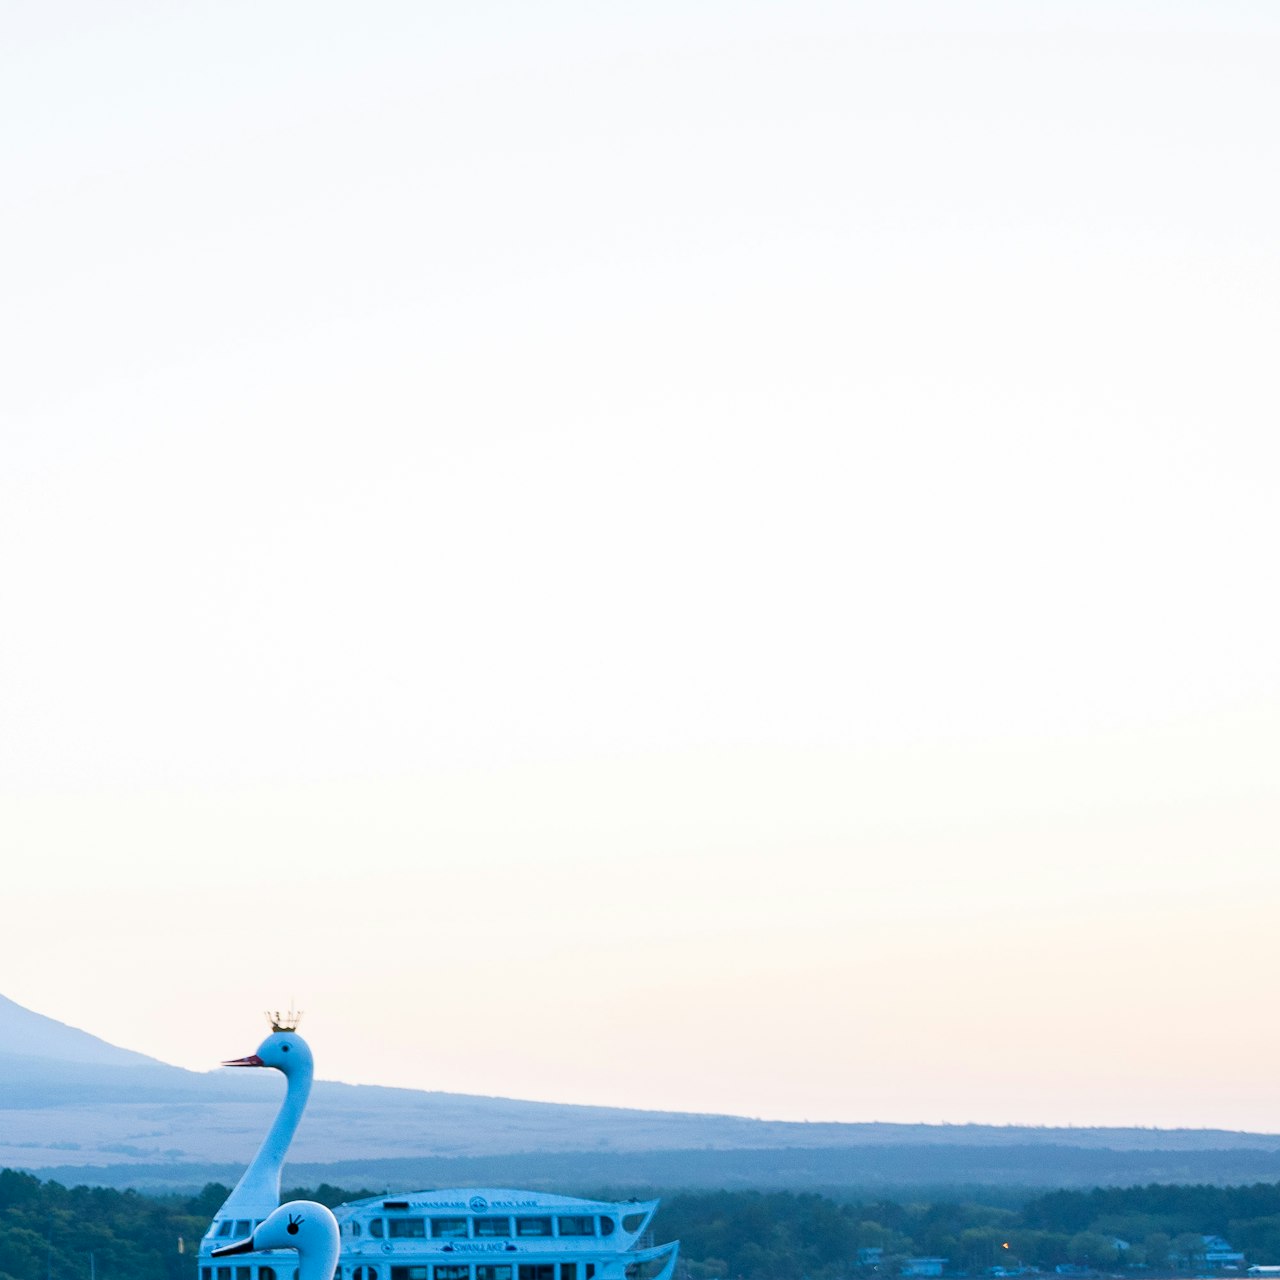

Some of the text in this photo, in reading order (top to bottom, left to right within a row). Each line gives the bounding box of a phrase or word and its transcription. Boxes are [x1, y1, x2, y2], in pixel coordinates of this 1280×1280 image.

[491, 1200, 514, 1208] SWAN
[515, 1200, 538, 1208] LAKE
[453, 1242, 504, 1252] SWAN LAKE
